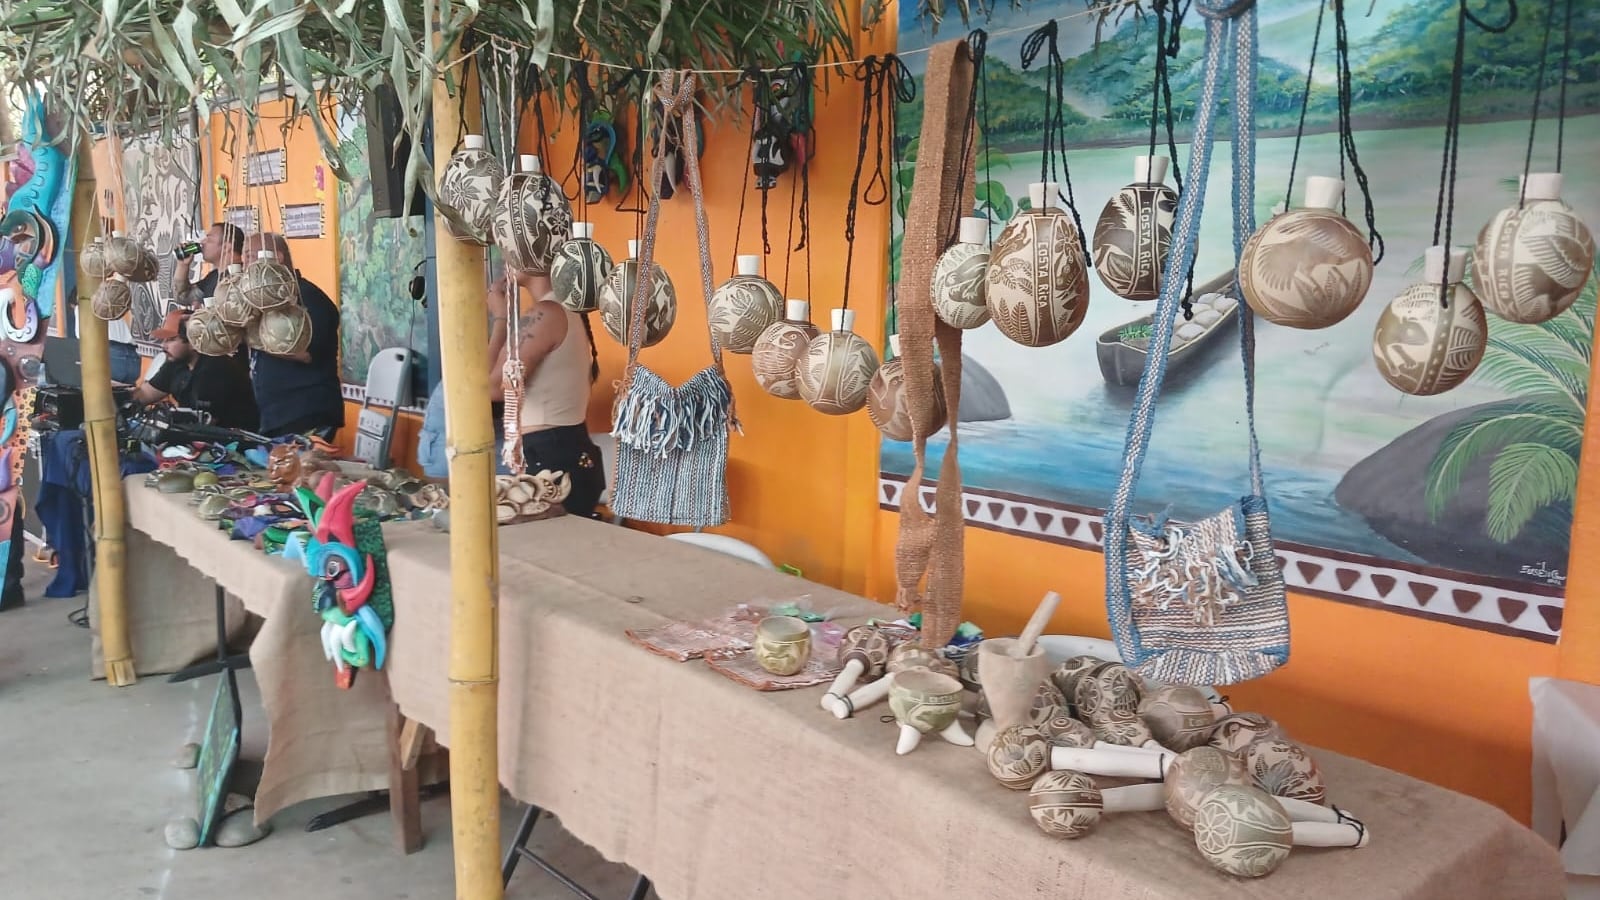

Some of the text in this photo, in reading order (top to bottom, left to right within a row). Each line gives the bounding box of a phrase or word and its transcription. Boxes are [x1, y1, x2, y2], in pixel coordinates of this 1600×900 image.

[512, 190, 521, 214] COSTA
[1140, 207, 1152, 246] COSTA
[1038, 241, 1049, 277] COSTA
